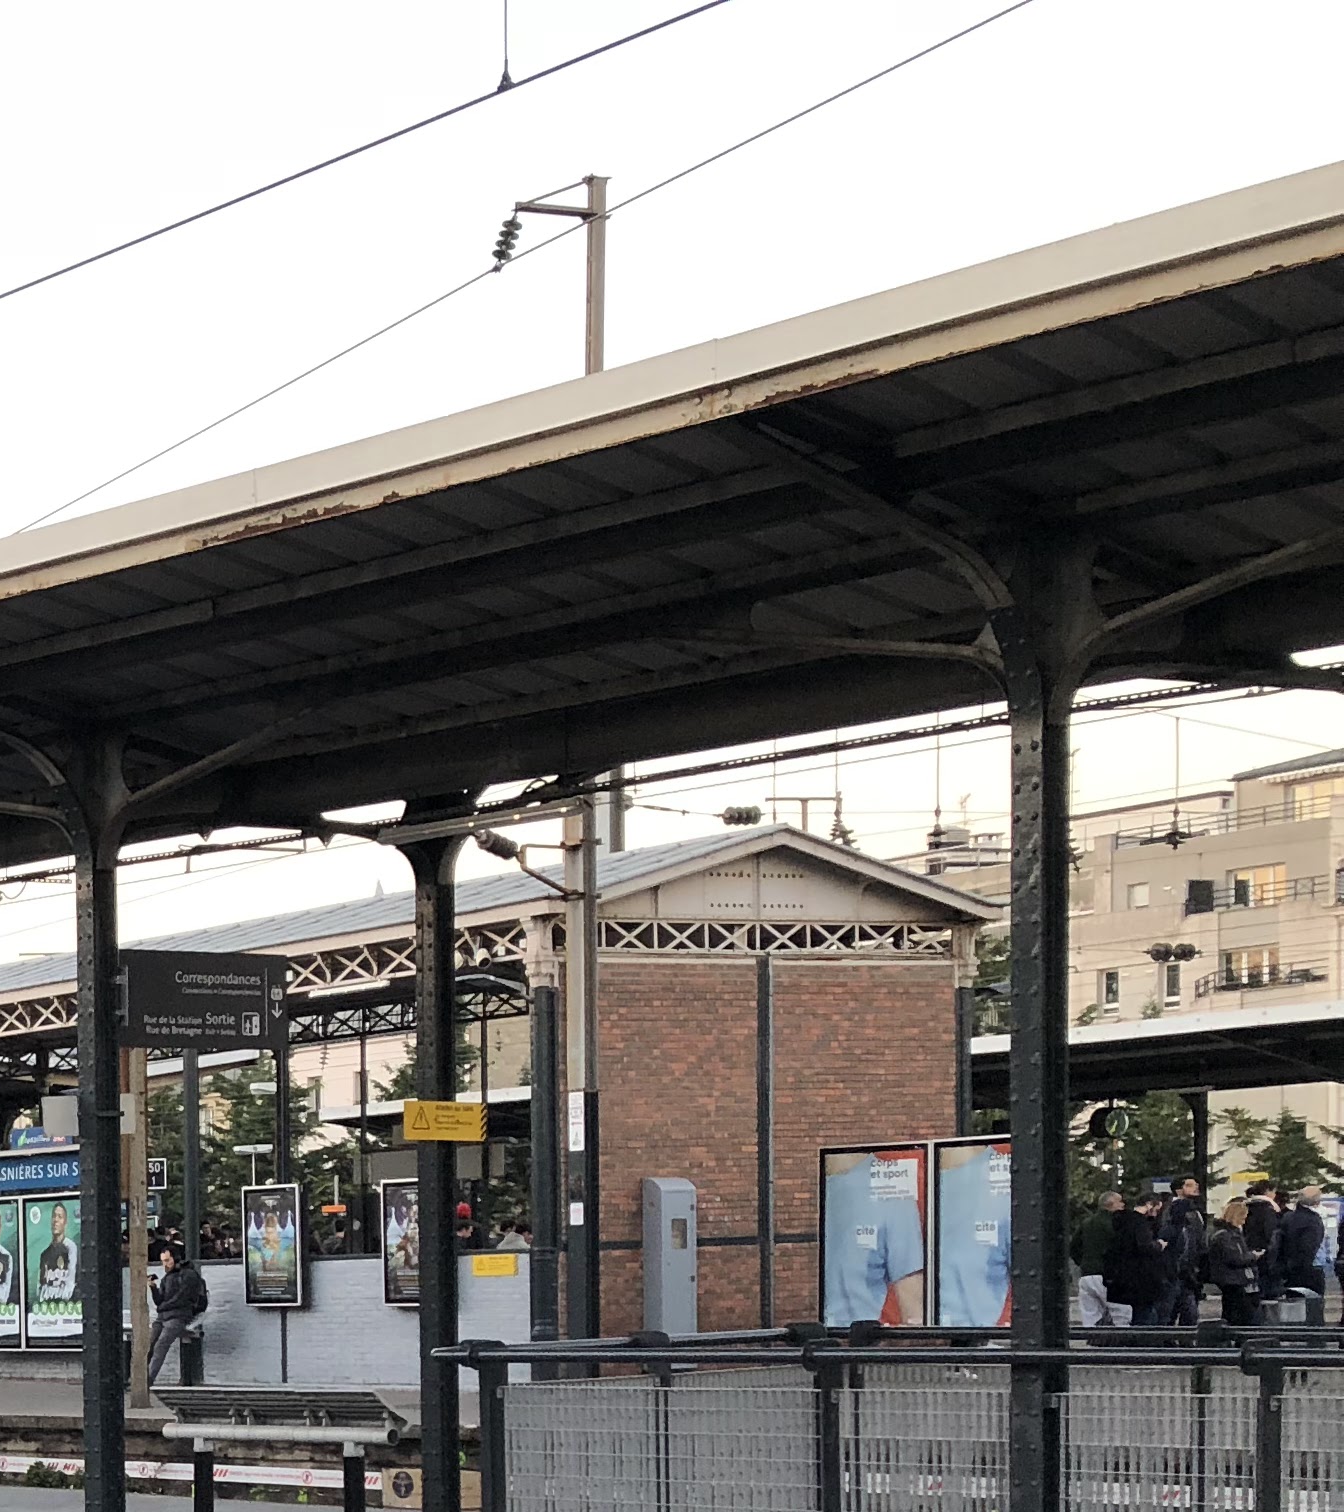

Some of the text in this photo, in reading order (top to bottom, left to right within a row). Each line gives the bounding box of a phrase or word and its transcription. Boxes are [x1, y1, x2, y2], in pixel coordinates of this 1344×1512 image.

[175, 970, 261, 986] Correspondances
[143, 1014, 158, 1024] Rue
[158, 1014, 168, 1024] de
[205, 1011, 236, 1025] Sortie
[46, 1163, 69, 1178] SUR
[870, 1158, 899, 1169] corps
[870, 1168, 909, 1180] et sport
